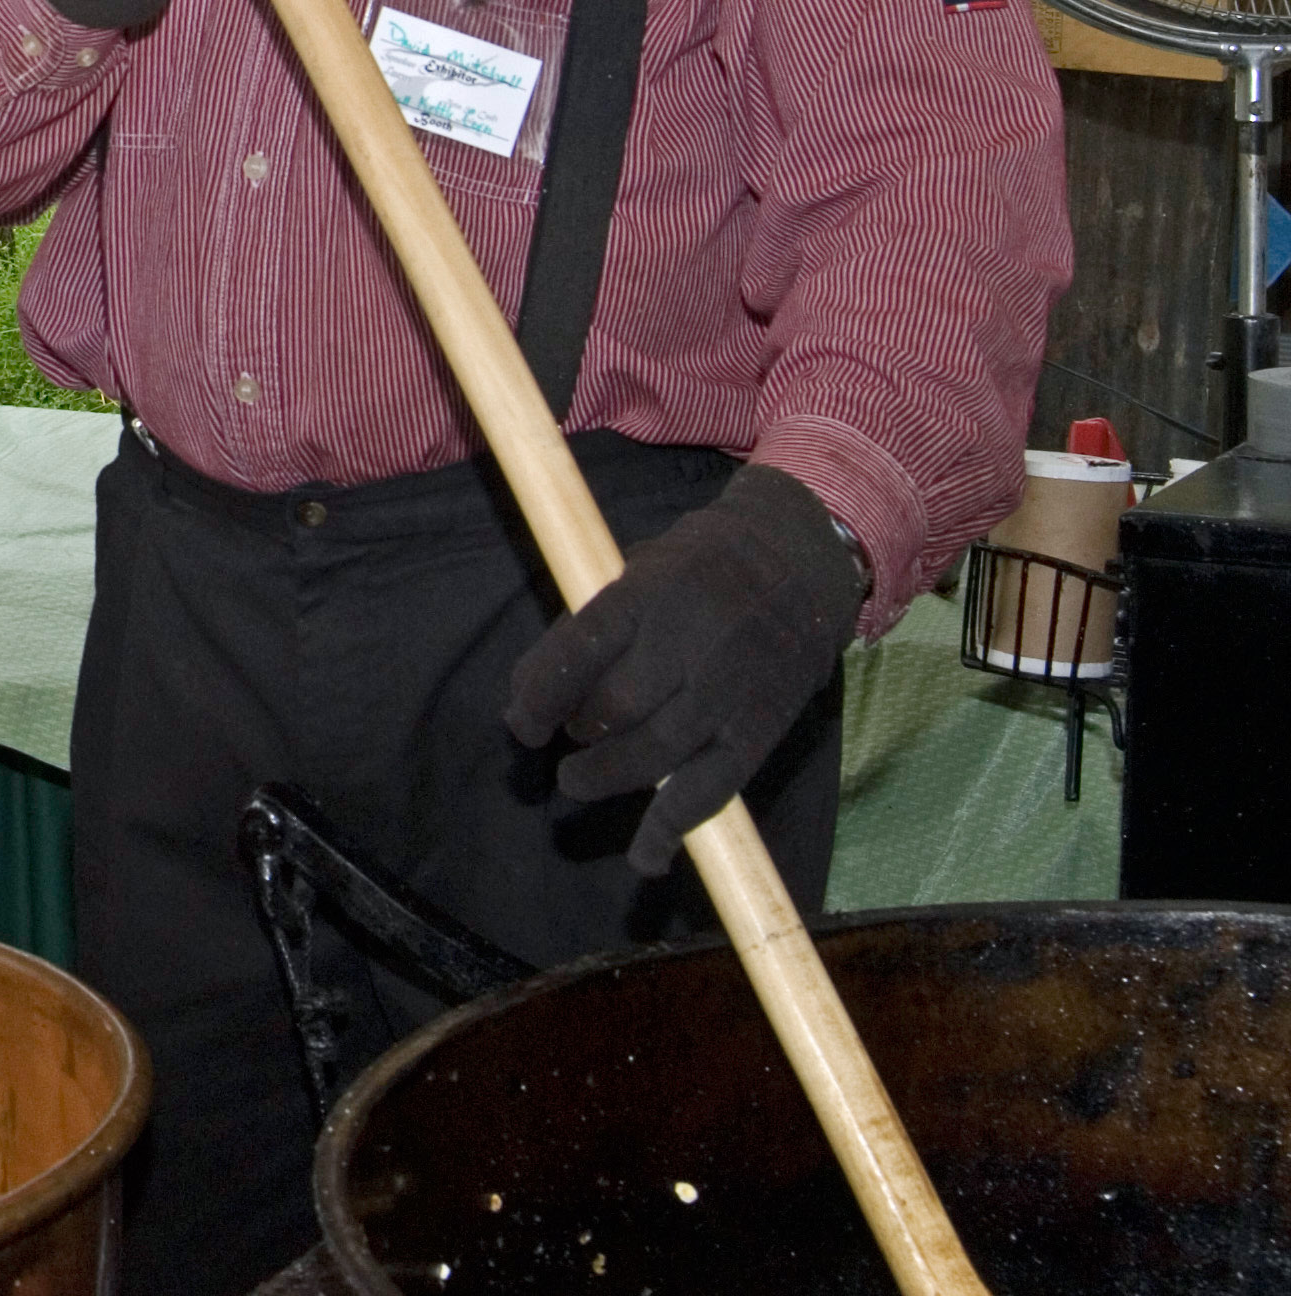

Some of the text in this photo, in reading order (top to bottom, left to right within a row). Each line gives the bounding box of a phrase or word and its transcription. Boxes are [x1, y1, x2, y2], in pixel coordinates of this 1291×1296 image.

[388, 21, 523, 88] David Mitchell
[424, 60, 477, 84] Exhibitor
[413, 113, 453, 132] Booth
